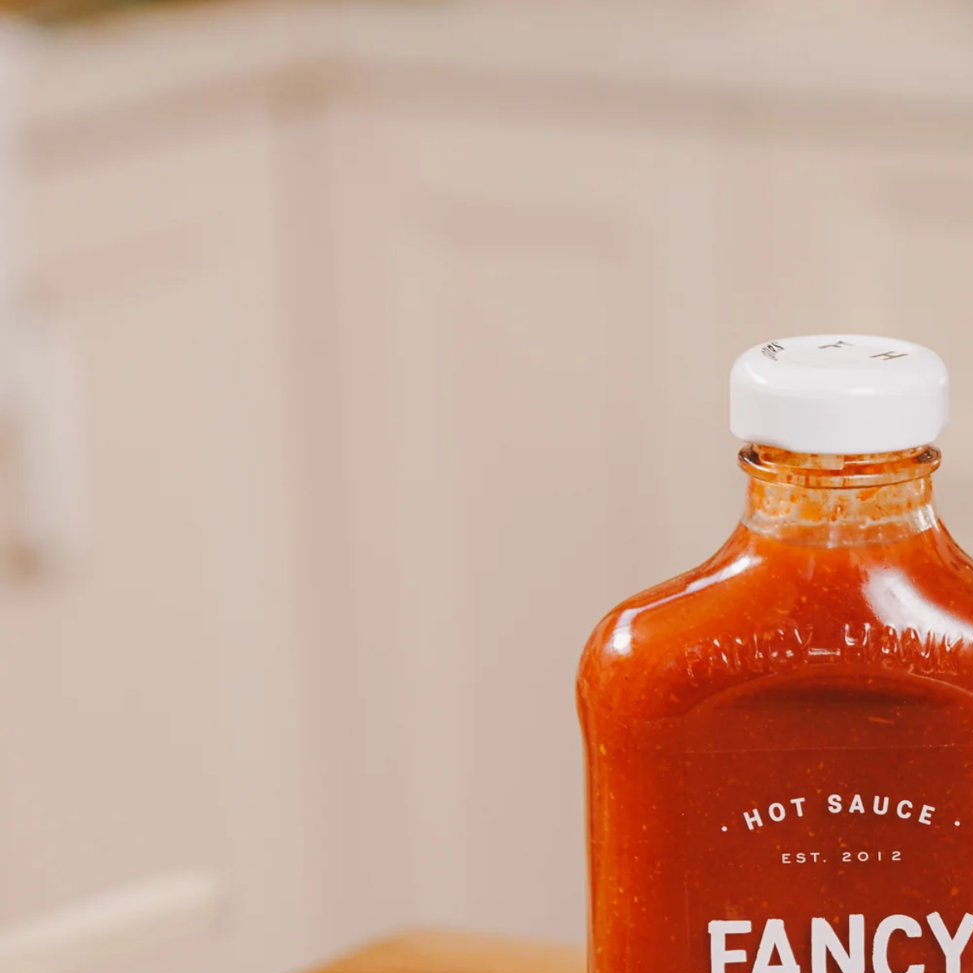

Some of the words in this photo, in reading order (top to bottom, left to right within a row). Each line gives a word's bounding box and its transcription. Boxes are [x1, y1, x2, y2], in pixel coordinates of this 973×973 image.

[744, 798, 805, 830] HOT
[828, 795, 935, 825] SAUCE
[782, 852, 827, 864] EST.
[842, 850, 901, 862] 2012
